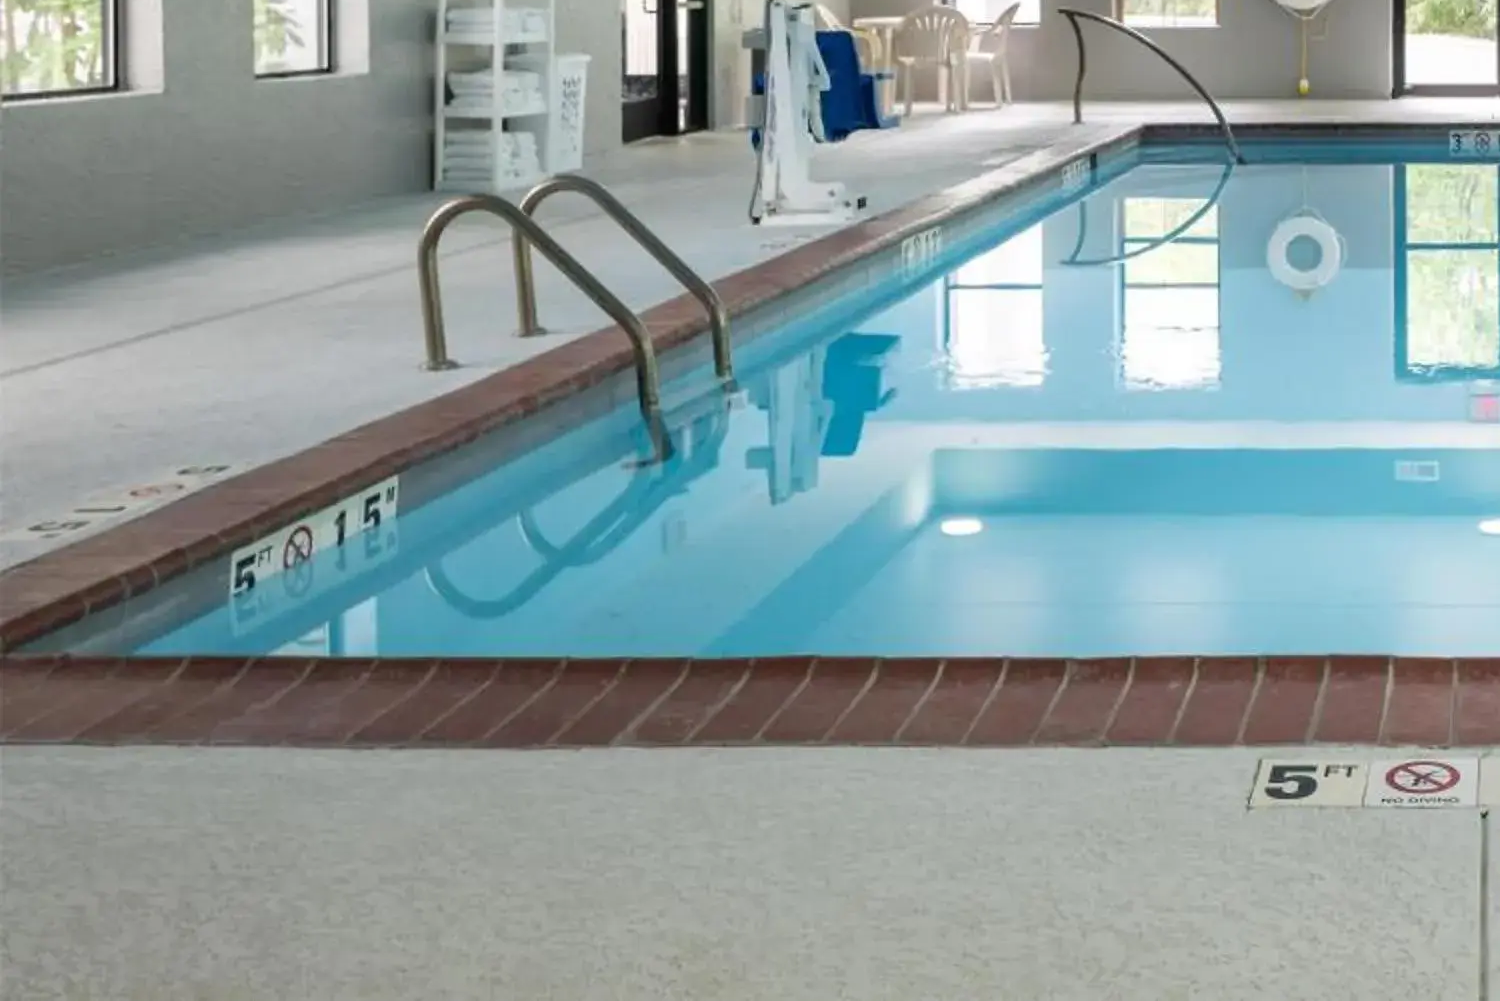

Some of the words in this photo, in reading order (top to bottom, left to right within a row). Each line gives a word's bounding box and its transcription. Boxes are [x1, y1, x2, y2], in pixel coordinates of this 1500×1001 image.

[234, 553, 257, 597] 5
[257, 544, 273, 568] FT
[1264, 765, 1318, 800] 5
[1323, 765, 1359, 778] FT
